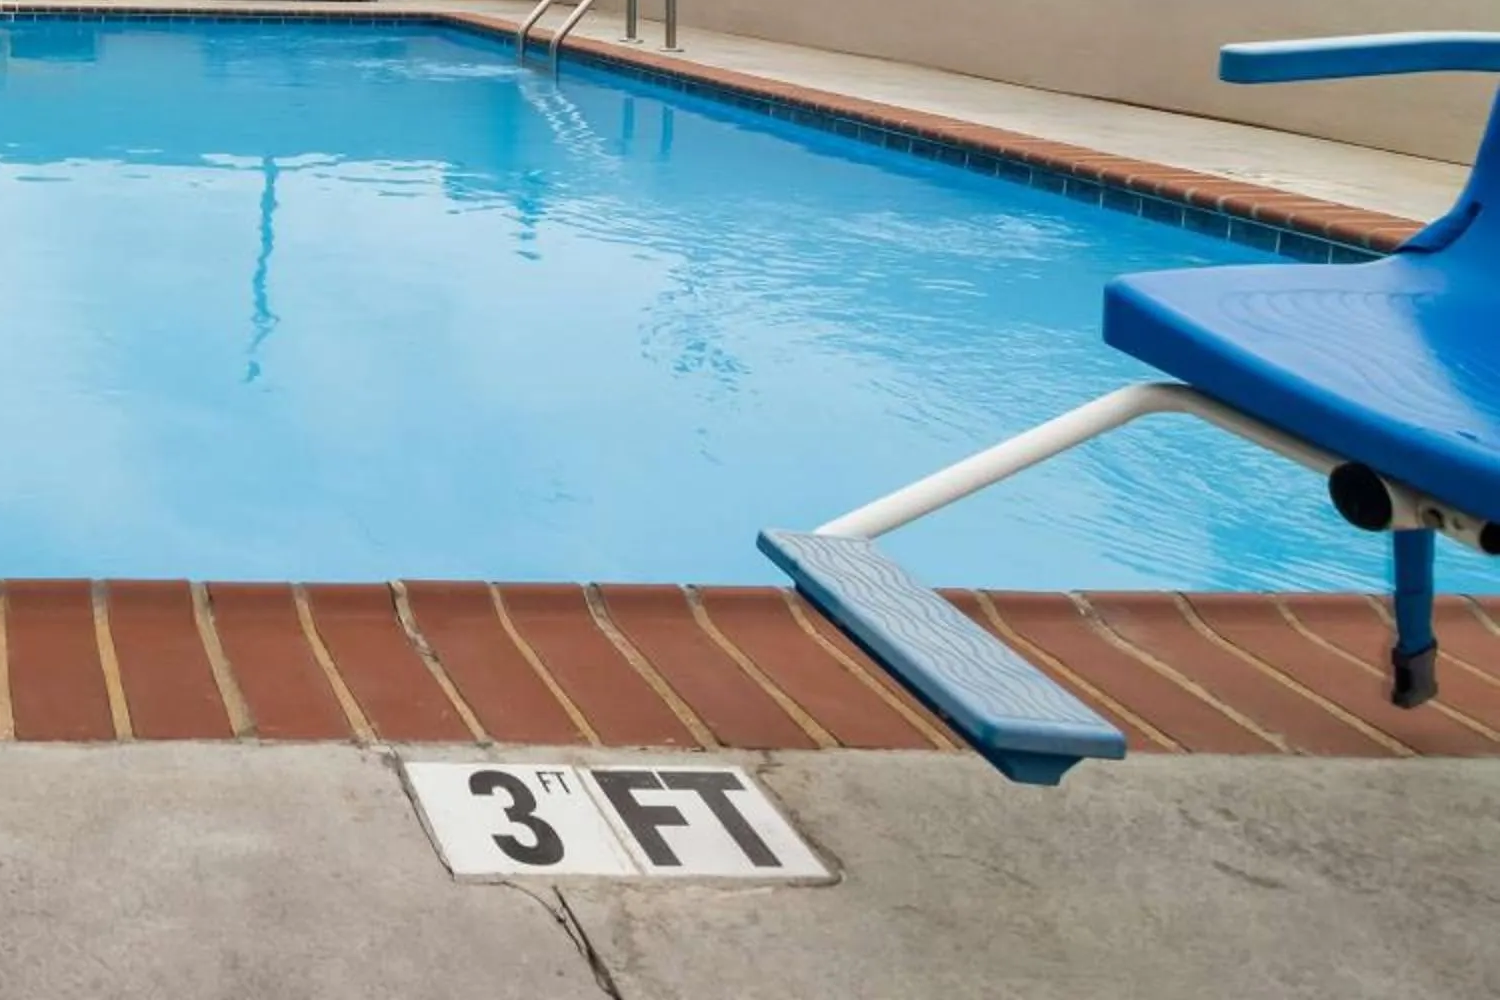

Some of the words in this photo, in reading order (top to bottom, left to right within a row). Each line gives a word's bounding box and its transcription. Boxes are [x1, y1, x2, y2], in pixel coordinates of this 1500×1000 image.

[467, 769, 565, 867] 3
[536, 770, 572, 795] FT
[590, 770, 783, 867] FT
